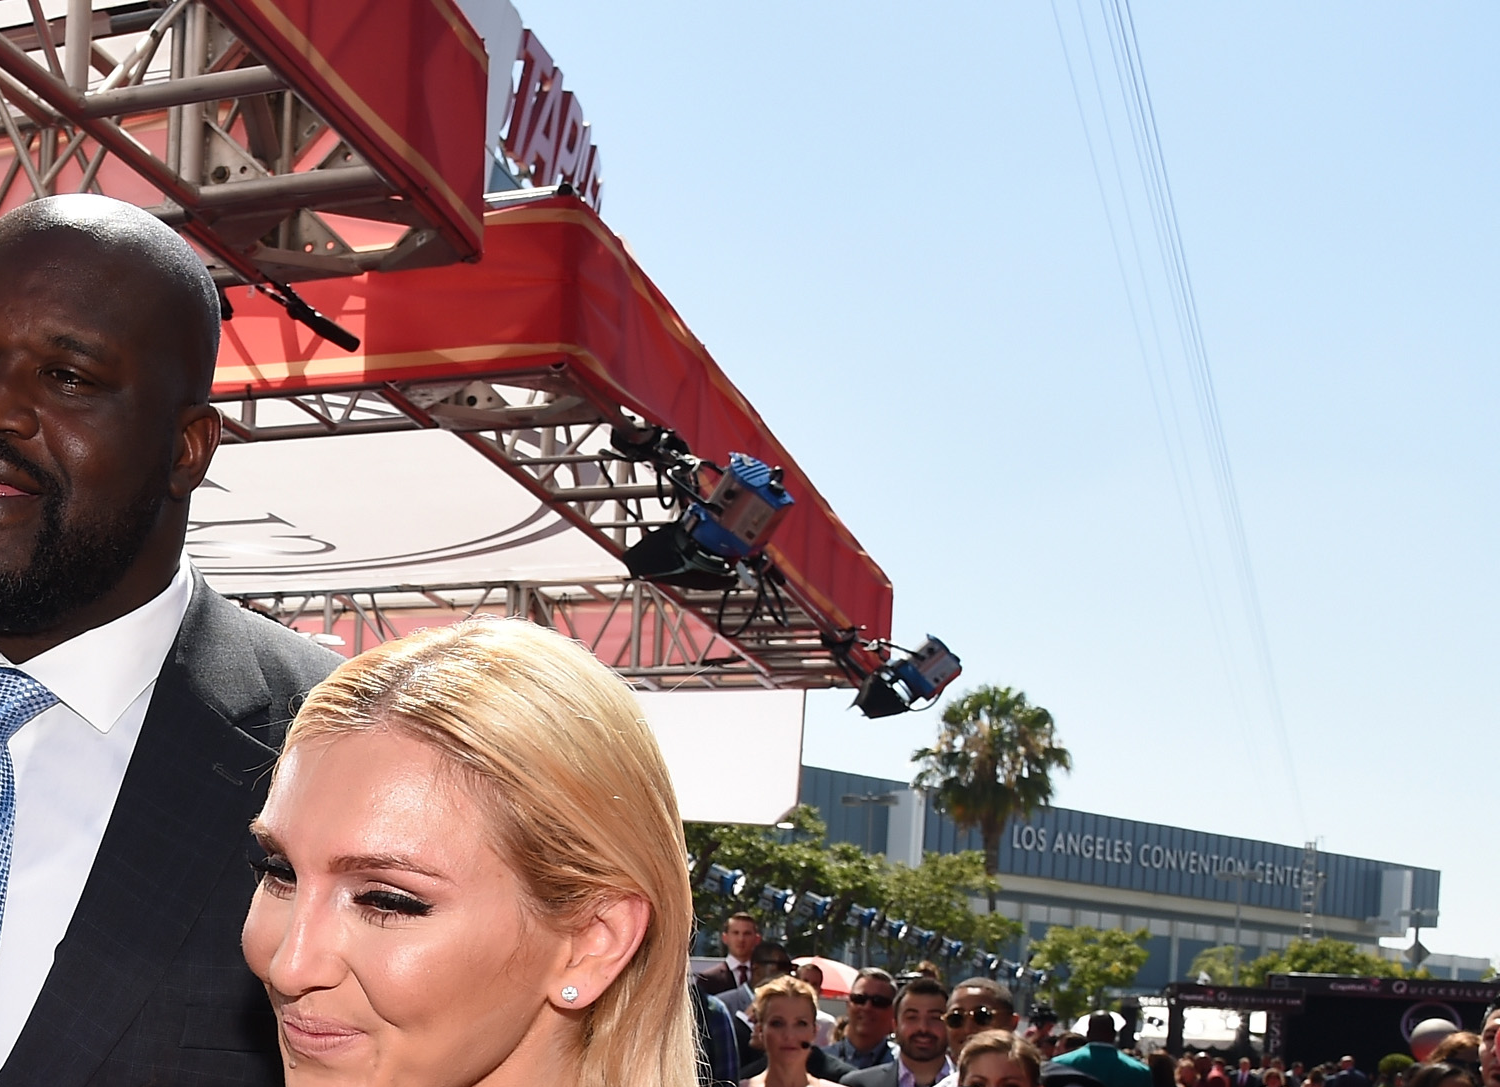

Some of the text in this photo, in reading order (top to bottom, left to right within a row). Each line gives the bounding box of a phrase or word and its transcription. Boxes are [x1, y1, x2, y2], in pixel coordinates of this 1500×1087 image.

[1012, 824, 1048, 852] LOS
[1053, 831, 1133, 865] ANGELES
[1138, 844, 1249, 878] CONVENTION
